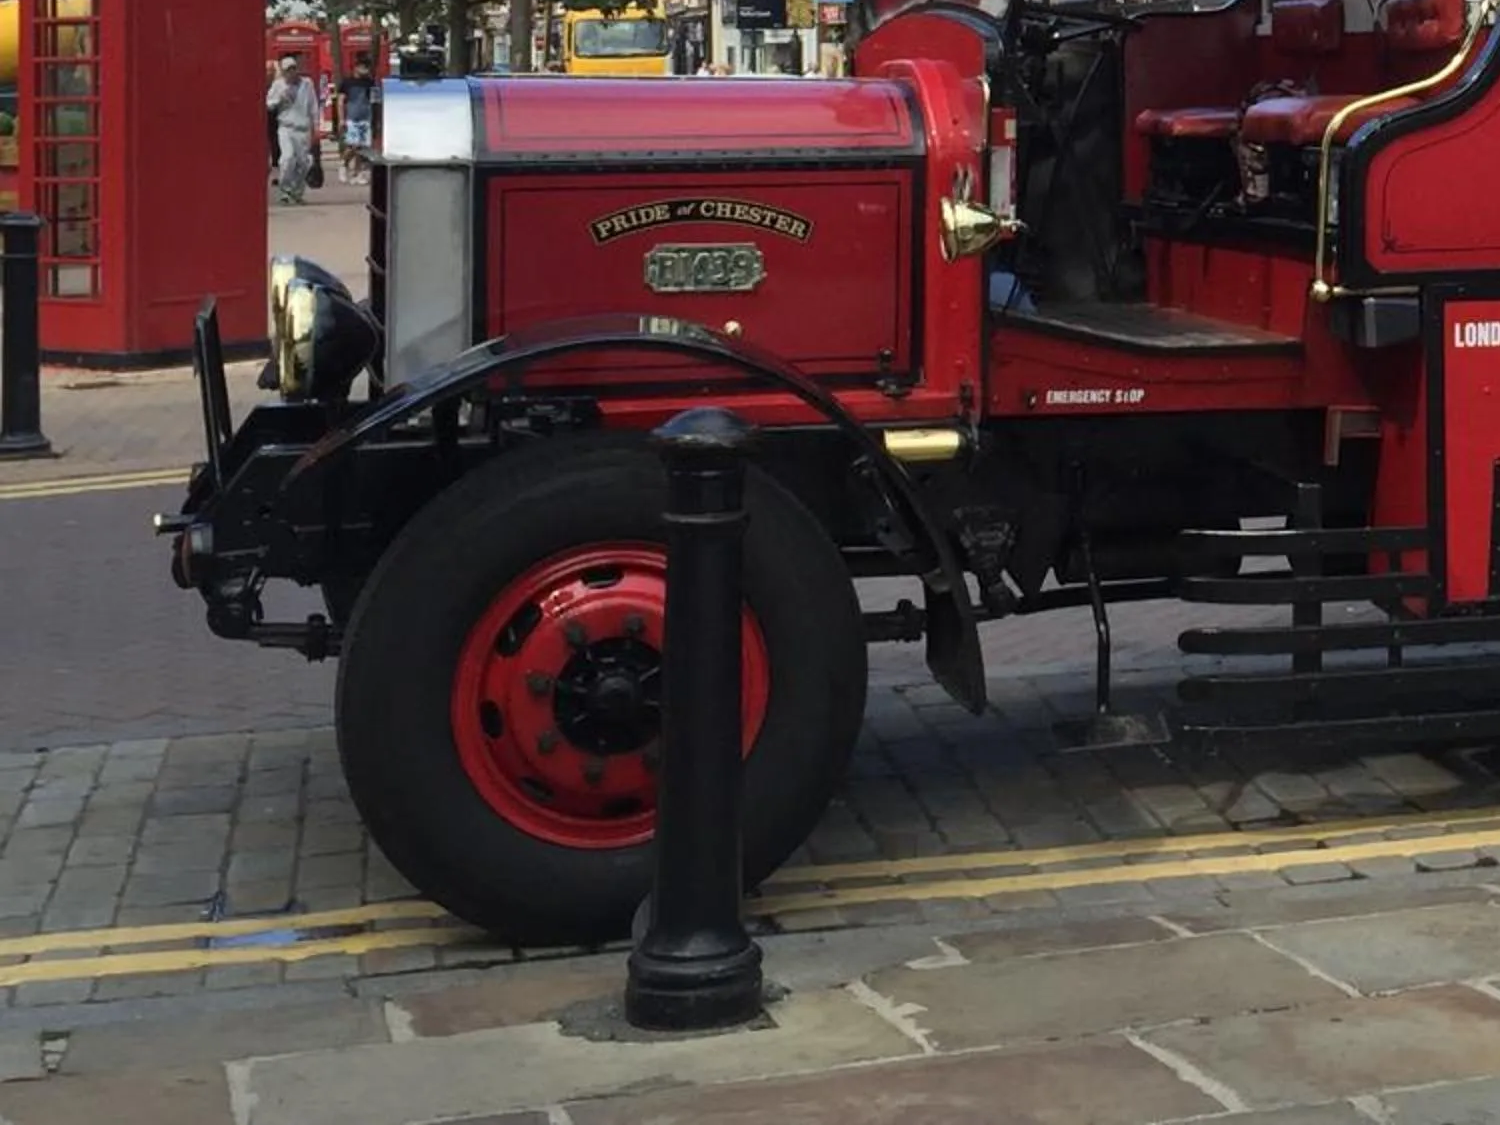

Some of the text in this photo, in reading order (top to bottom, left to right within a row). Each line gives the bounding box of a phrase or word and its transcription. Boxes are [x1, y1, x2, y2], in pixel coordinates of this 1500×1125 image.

[597, 200, 806, 238] PRIDE of CHESTER
[1046, 390, 1111, 404] EMERGENCY
